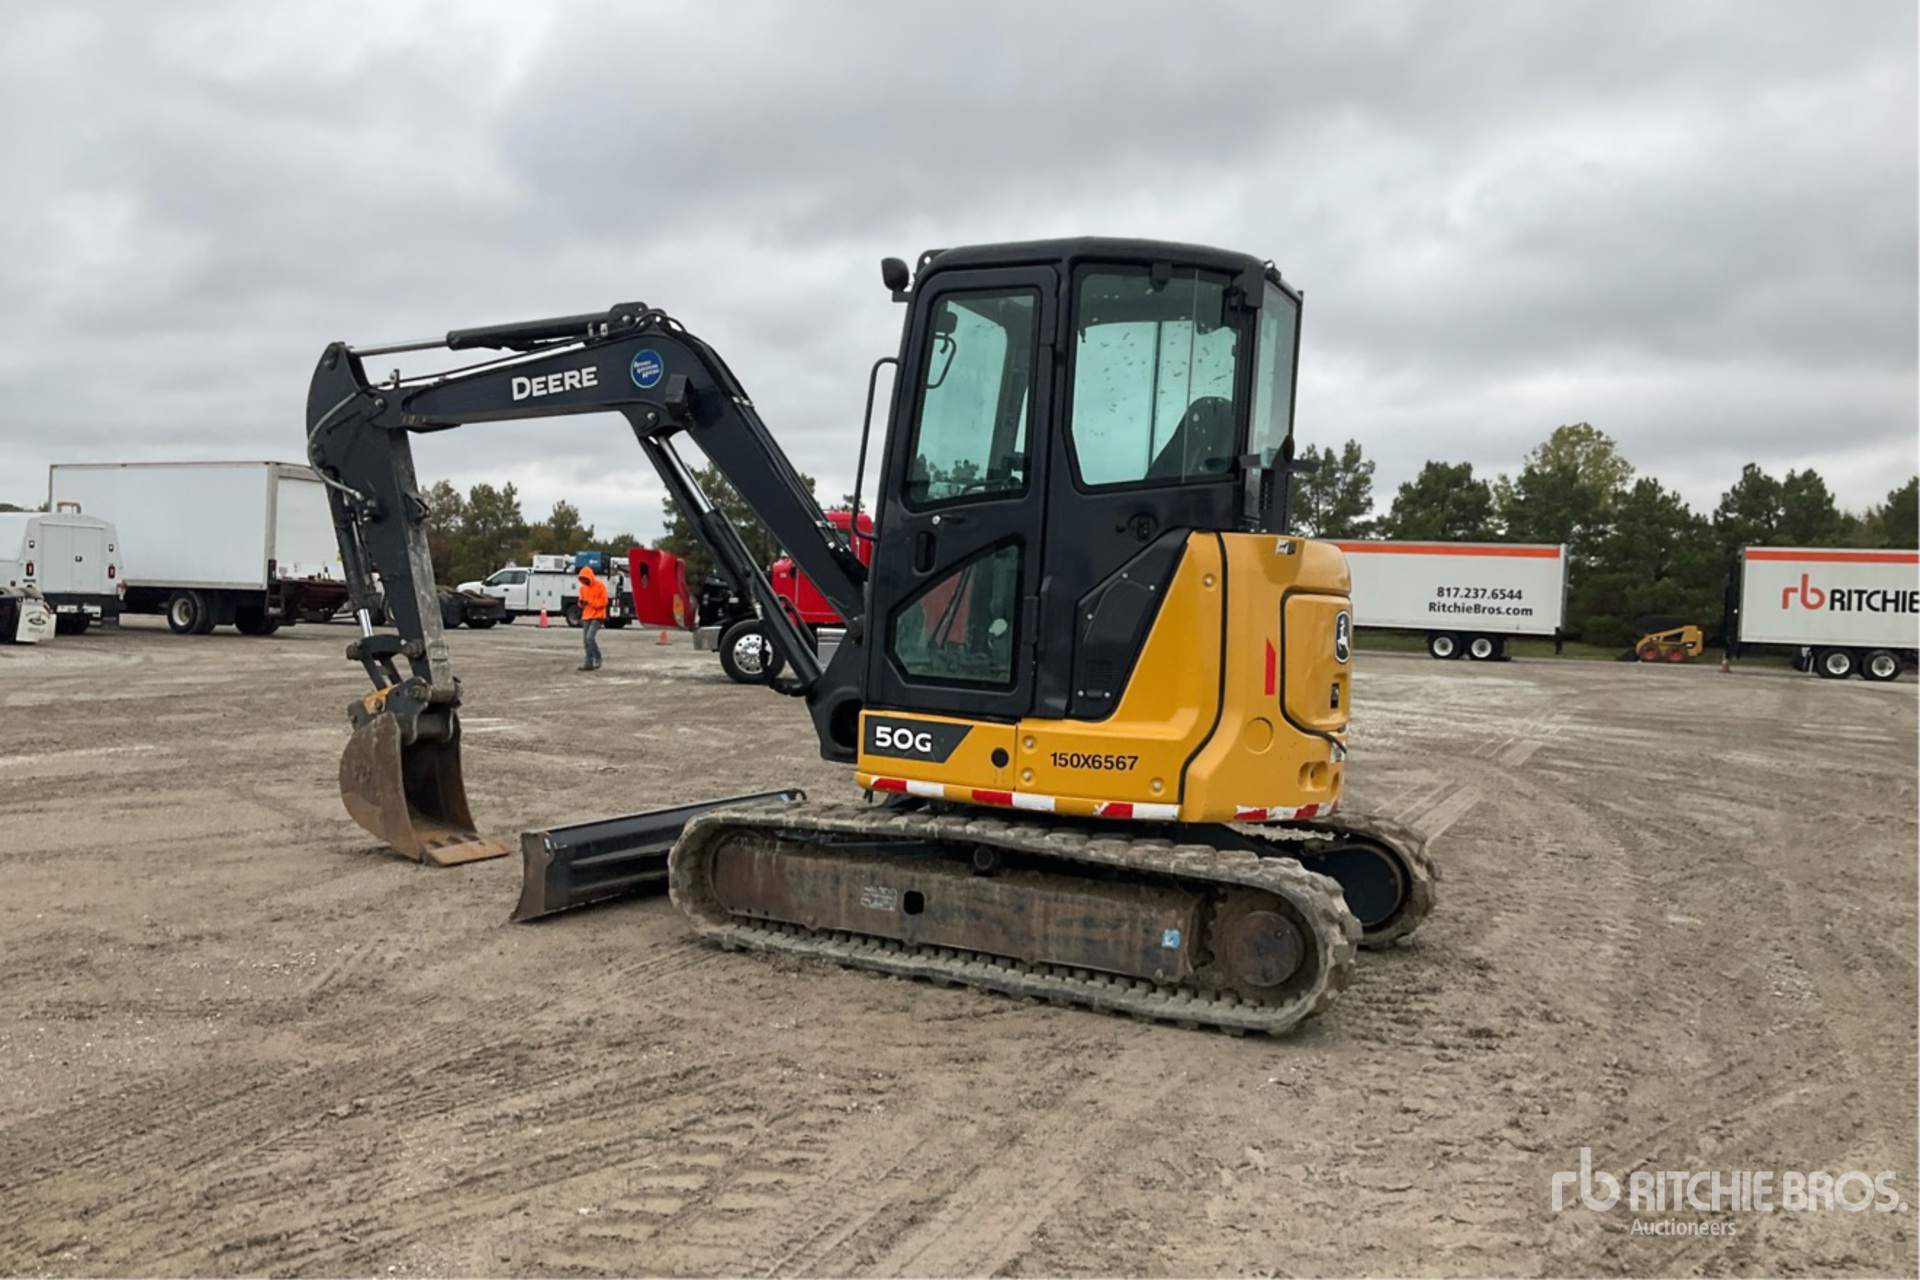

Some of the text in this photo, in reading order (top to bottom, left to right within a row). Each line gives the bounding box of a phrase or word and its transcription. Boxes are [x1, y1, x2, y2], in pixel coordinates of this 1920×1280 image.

[511, 366, 598, 401] DEERE
[1436, 586, 1523, 600] 817.237.6544
[1781, 573, 1919, 613] rb RITCHIE
[1428, 602, 1533, 616] RitchieBros.com
[874, 725, 932, 753] 50G
[1050, 751, 1139, 772] 150X6567
